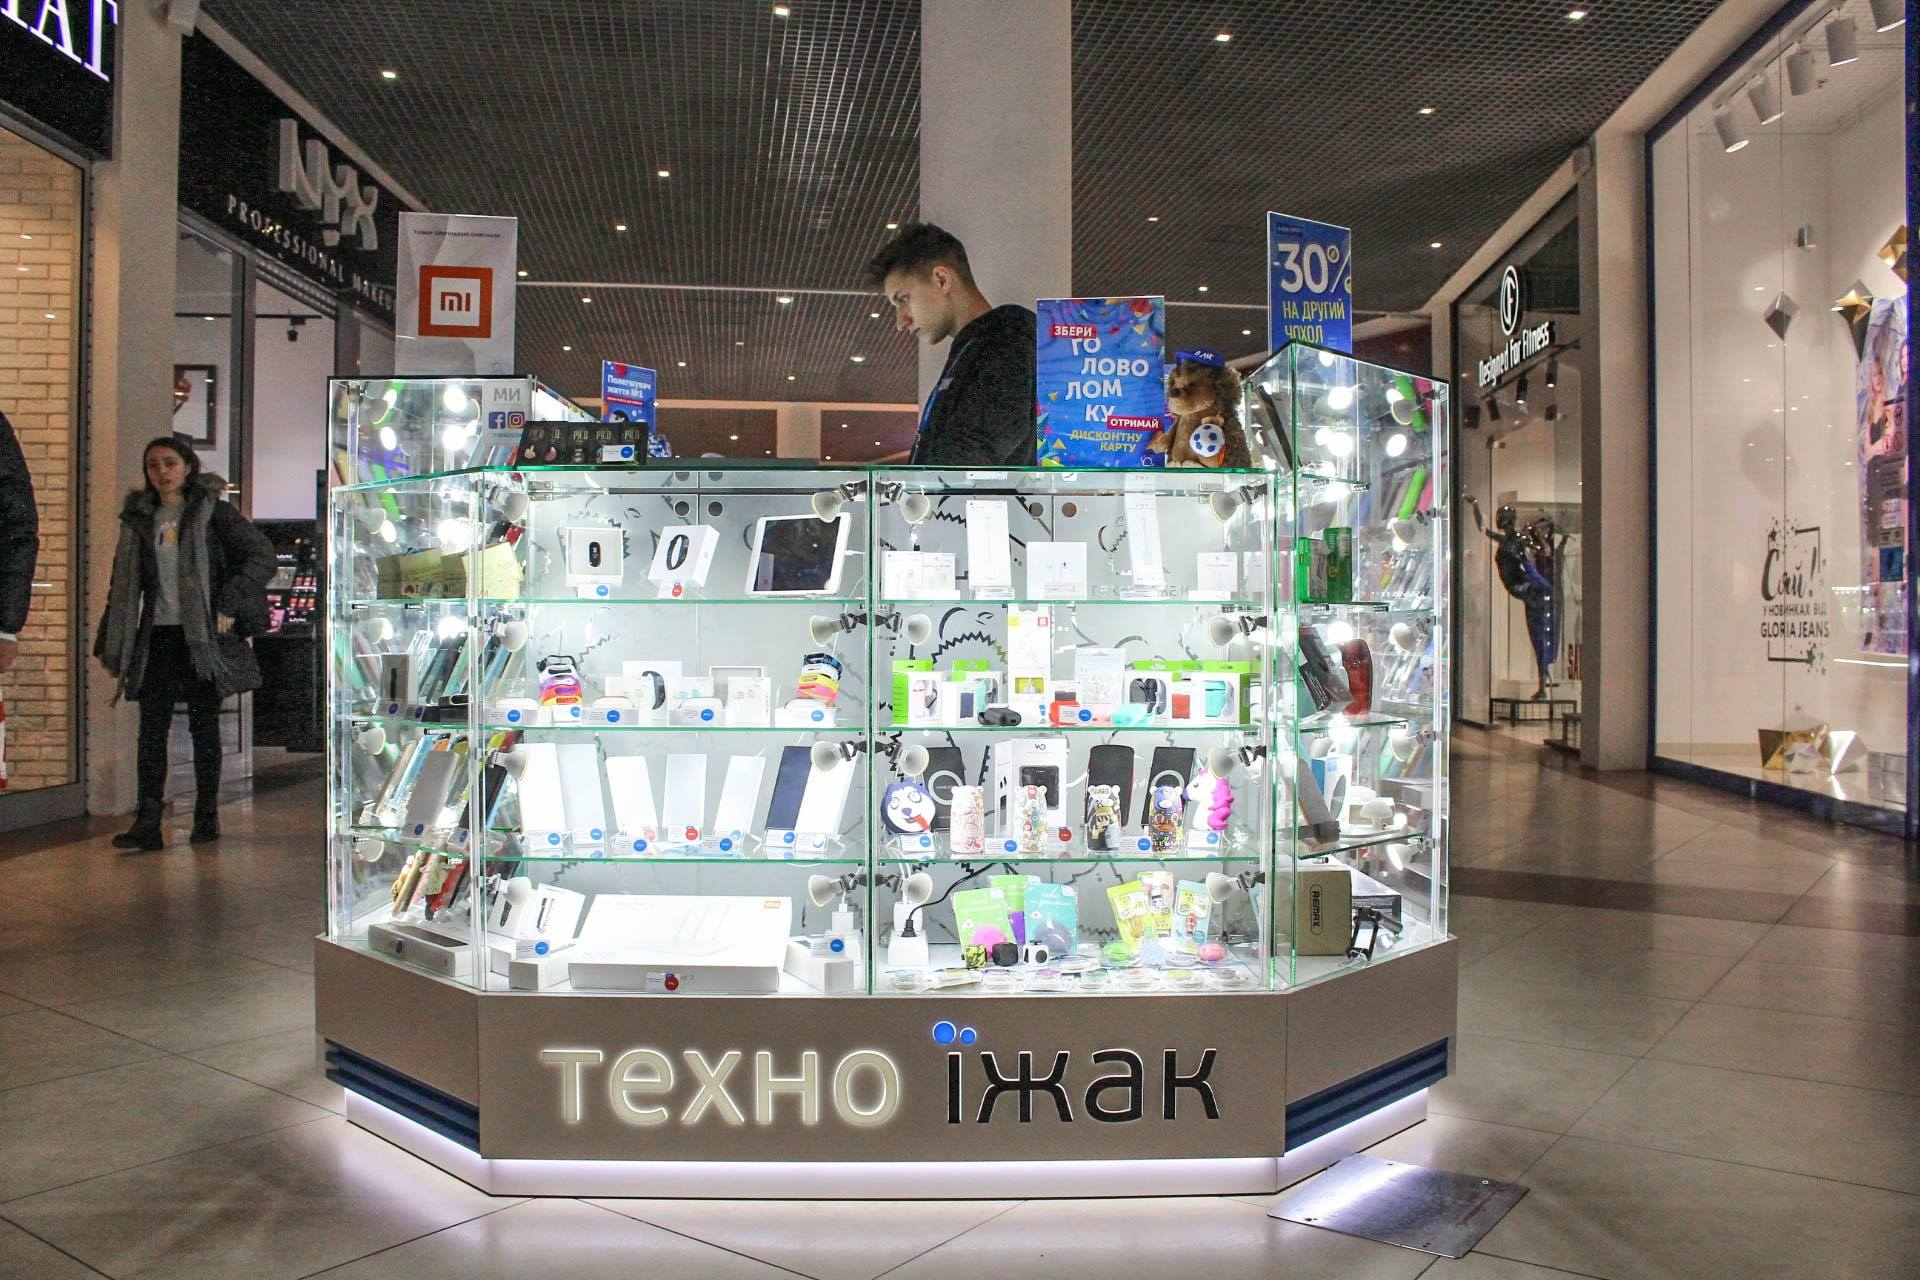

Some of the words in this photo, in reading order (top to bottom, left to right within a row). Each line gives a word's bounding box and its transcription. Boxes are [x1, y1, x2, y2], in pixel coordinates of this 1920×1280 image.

[0, 0, 118, 81] AT
[228, 193, 344, 283] PROFESSIONAL
[1283, 300, 1299, 319] НА
[1302, 298, 1345, 322] ДРУГИЙ
[1054, 325, 1093, 337] ЗБЕРИ
[1284, 324, 1324, 343] ЧОХОЛ
[1071, 337, 1101, 356] ГО
[1479, 342, 1509, 388] Designed
[1510, 338, 1522, 368] for
[1522, 321, 1550, 359] Fitness
[1080, 357, 1149, 377] ЛОВО
[1065, 379, 1123, 400] ЛОМ
[1085, 403, 1116, 423] КУ
[1110, 416, 1159, 429] ОТРИМАЙ
[1070, 429, 1143, 443] ДИСКОНТНУ
[1100, 441, 1137, 453] КАРТУ
[1768, 603, 1811, 617] НОВИНКАХ
[1760, 621, 1797, 638] GLORIA
[1797, 621, 1830, 638] JEANS
[931, 1020, 1221, 1125] їжак
